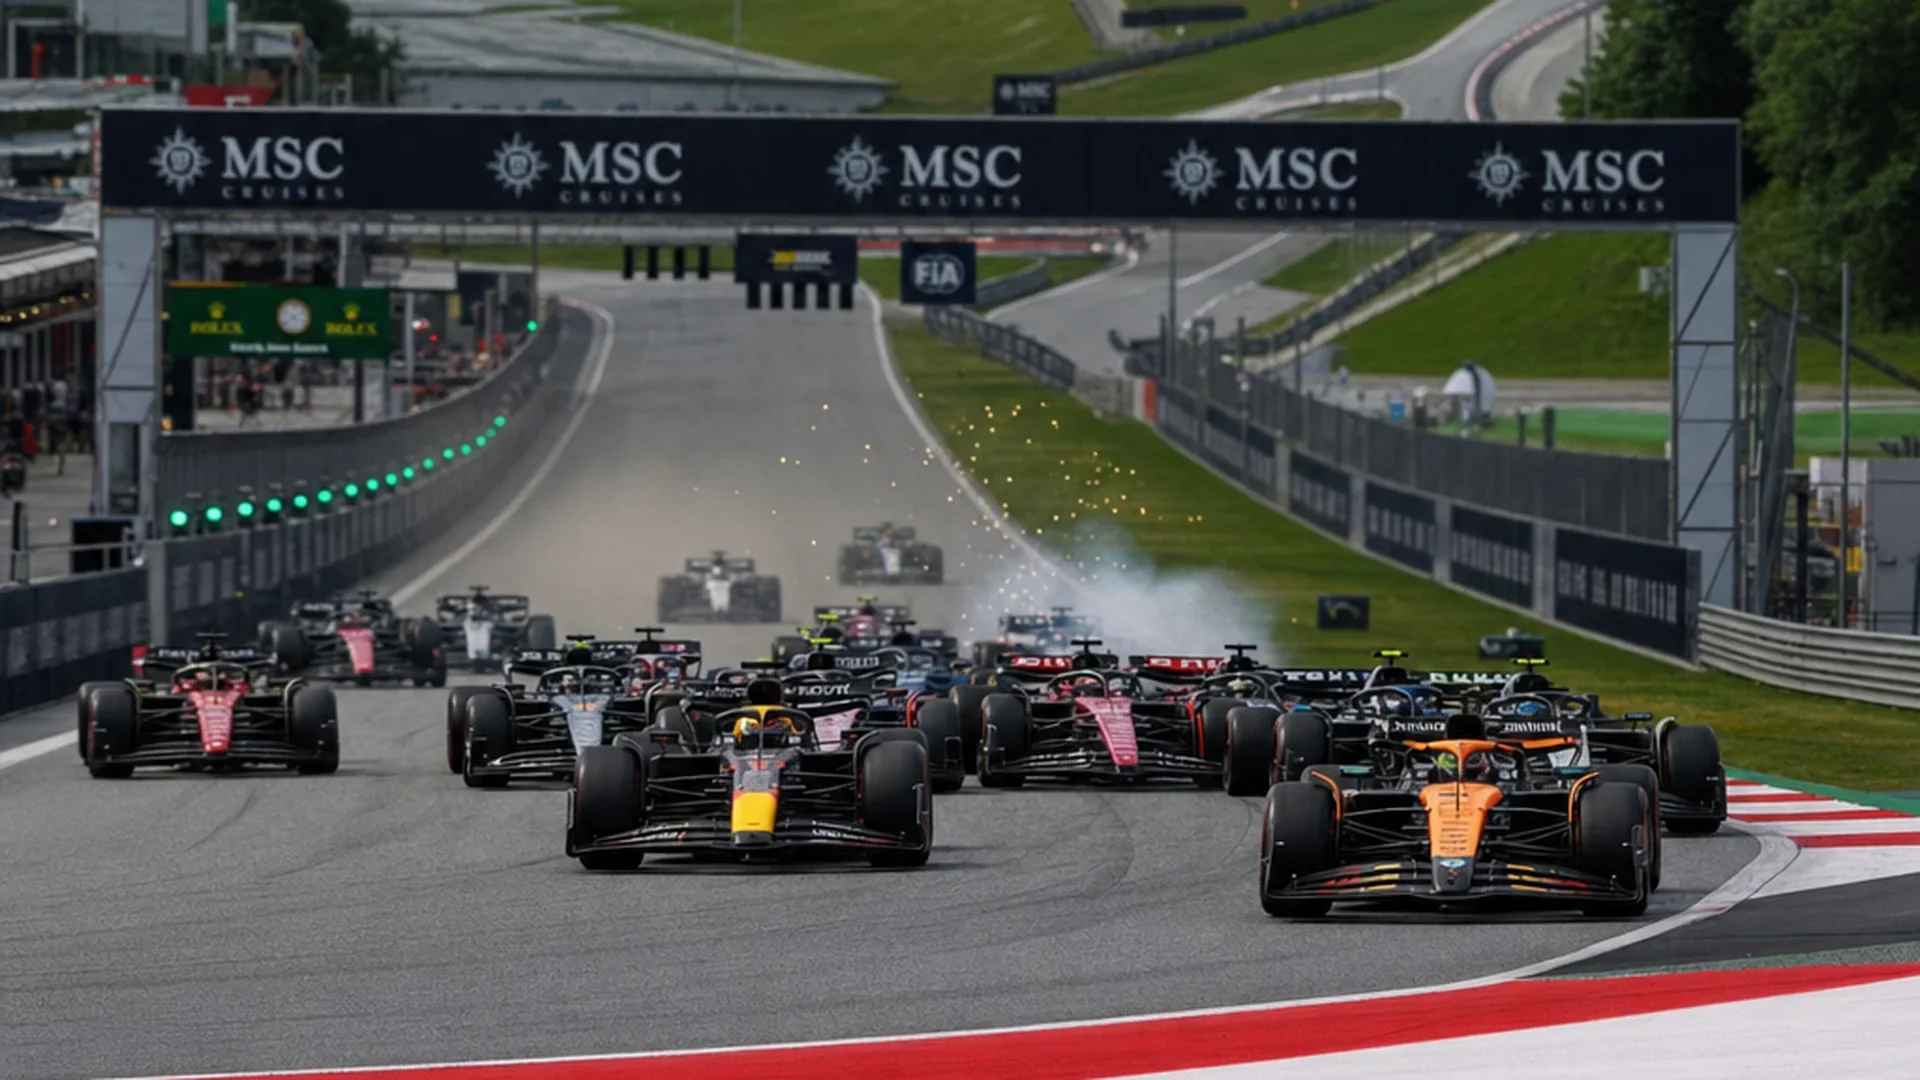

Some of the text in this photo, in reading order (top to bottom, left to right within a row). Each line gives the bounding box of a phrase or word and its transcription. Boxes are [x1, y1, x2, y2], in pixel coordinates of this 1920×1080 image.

[221, 136, 344, 180] MSC
[560, 141, 683, 185] MSC
[899, 145, 1022, 188] MSC
[1235, 147, 1358, 190] MSC
[1541, 149, 1665, 193] MSC
[221, 186, 344, 200] CRUISES
[560, 190, 682, 205] CRUISES
[899, 194, 1021, 208] CRUISES
[1235, 197, 1357, 211] CRUISES
[1541, 199, 1665, 213] CRUISES
[915, 261, 960, 286] FIA
[190, 321, 243, 335] ROLEX
[326, 322, 378, 336] ROLEX
